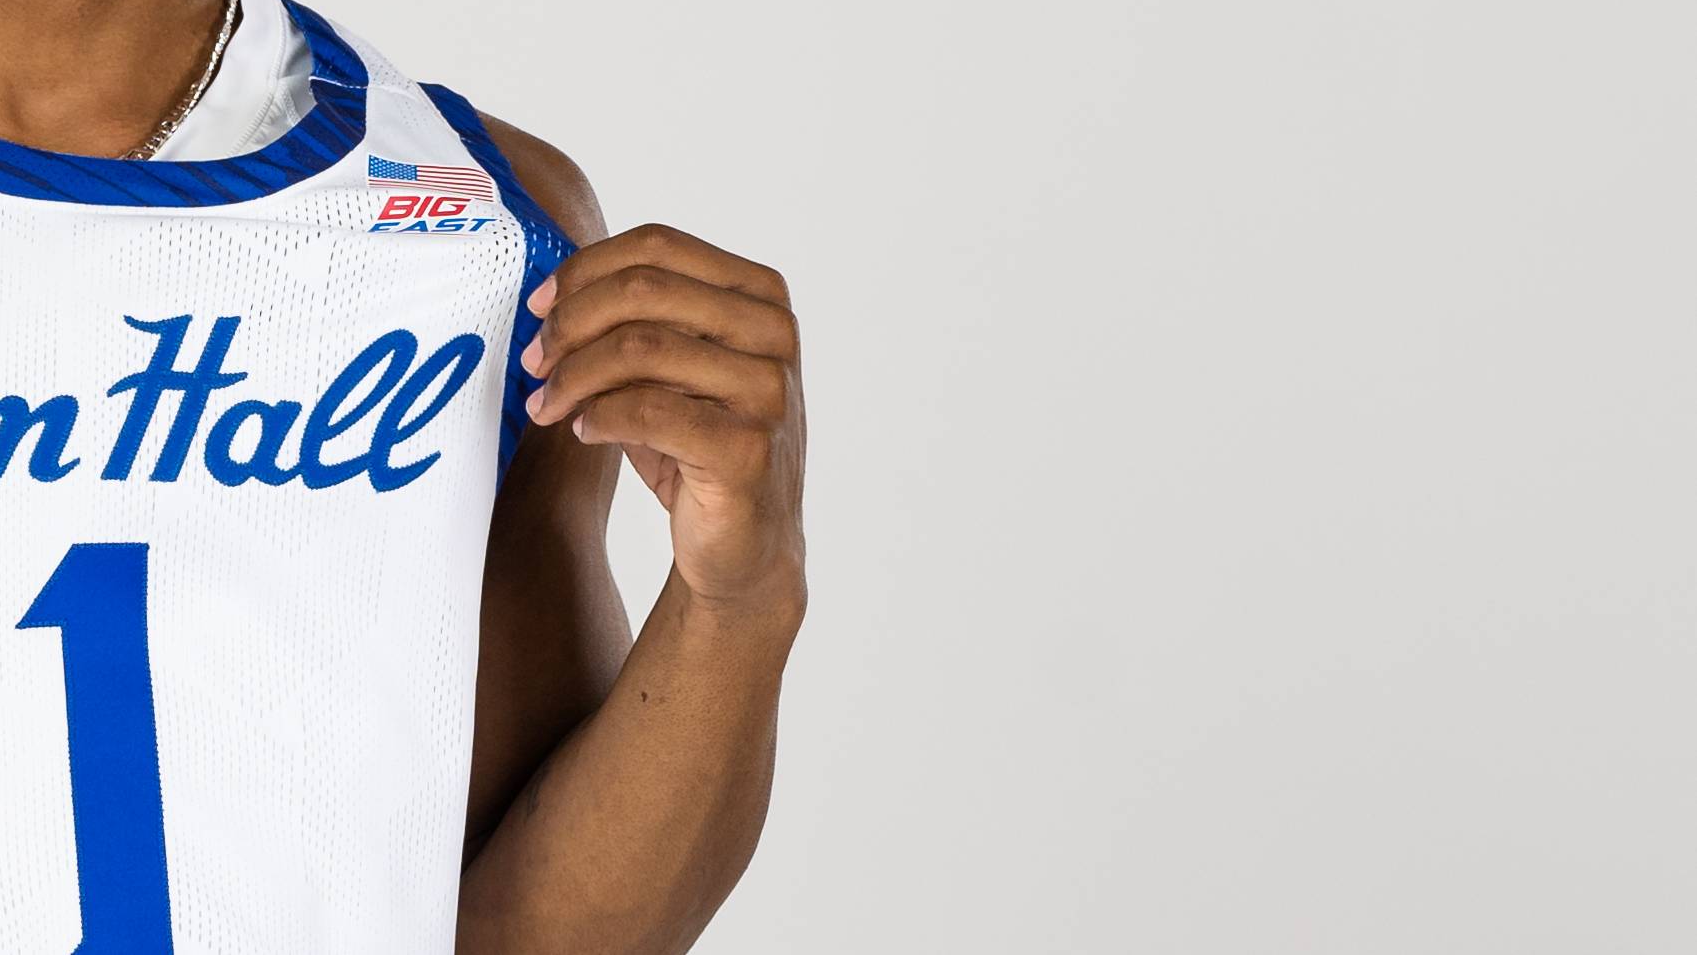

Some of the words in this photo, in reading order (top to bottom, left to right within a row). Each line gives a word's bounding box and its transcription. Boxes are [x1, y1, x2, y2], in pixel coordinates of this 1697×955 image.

[367, 218, 499, 233] EAST
[378, 196, 472, 220] BIG
[102, 315, 486, 493] Hall
[15, 542, 174, 955] 1
